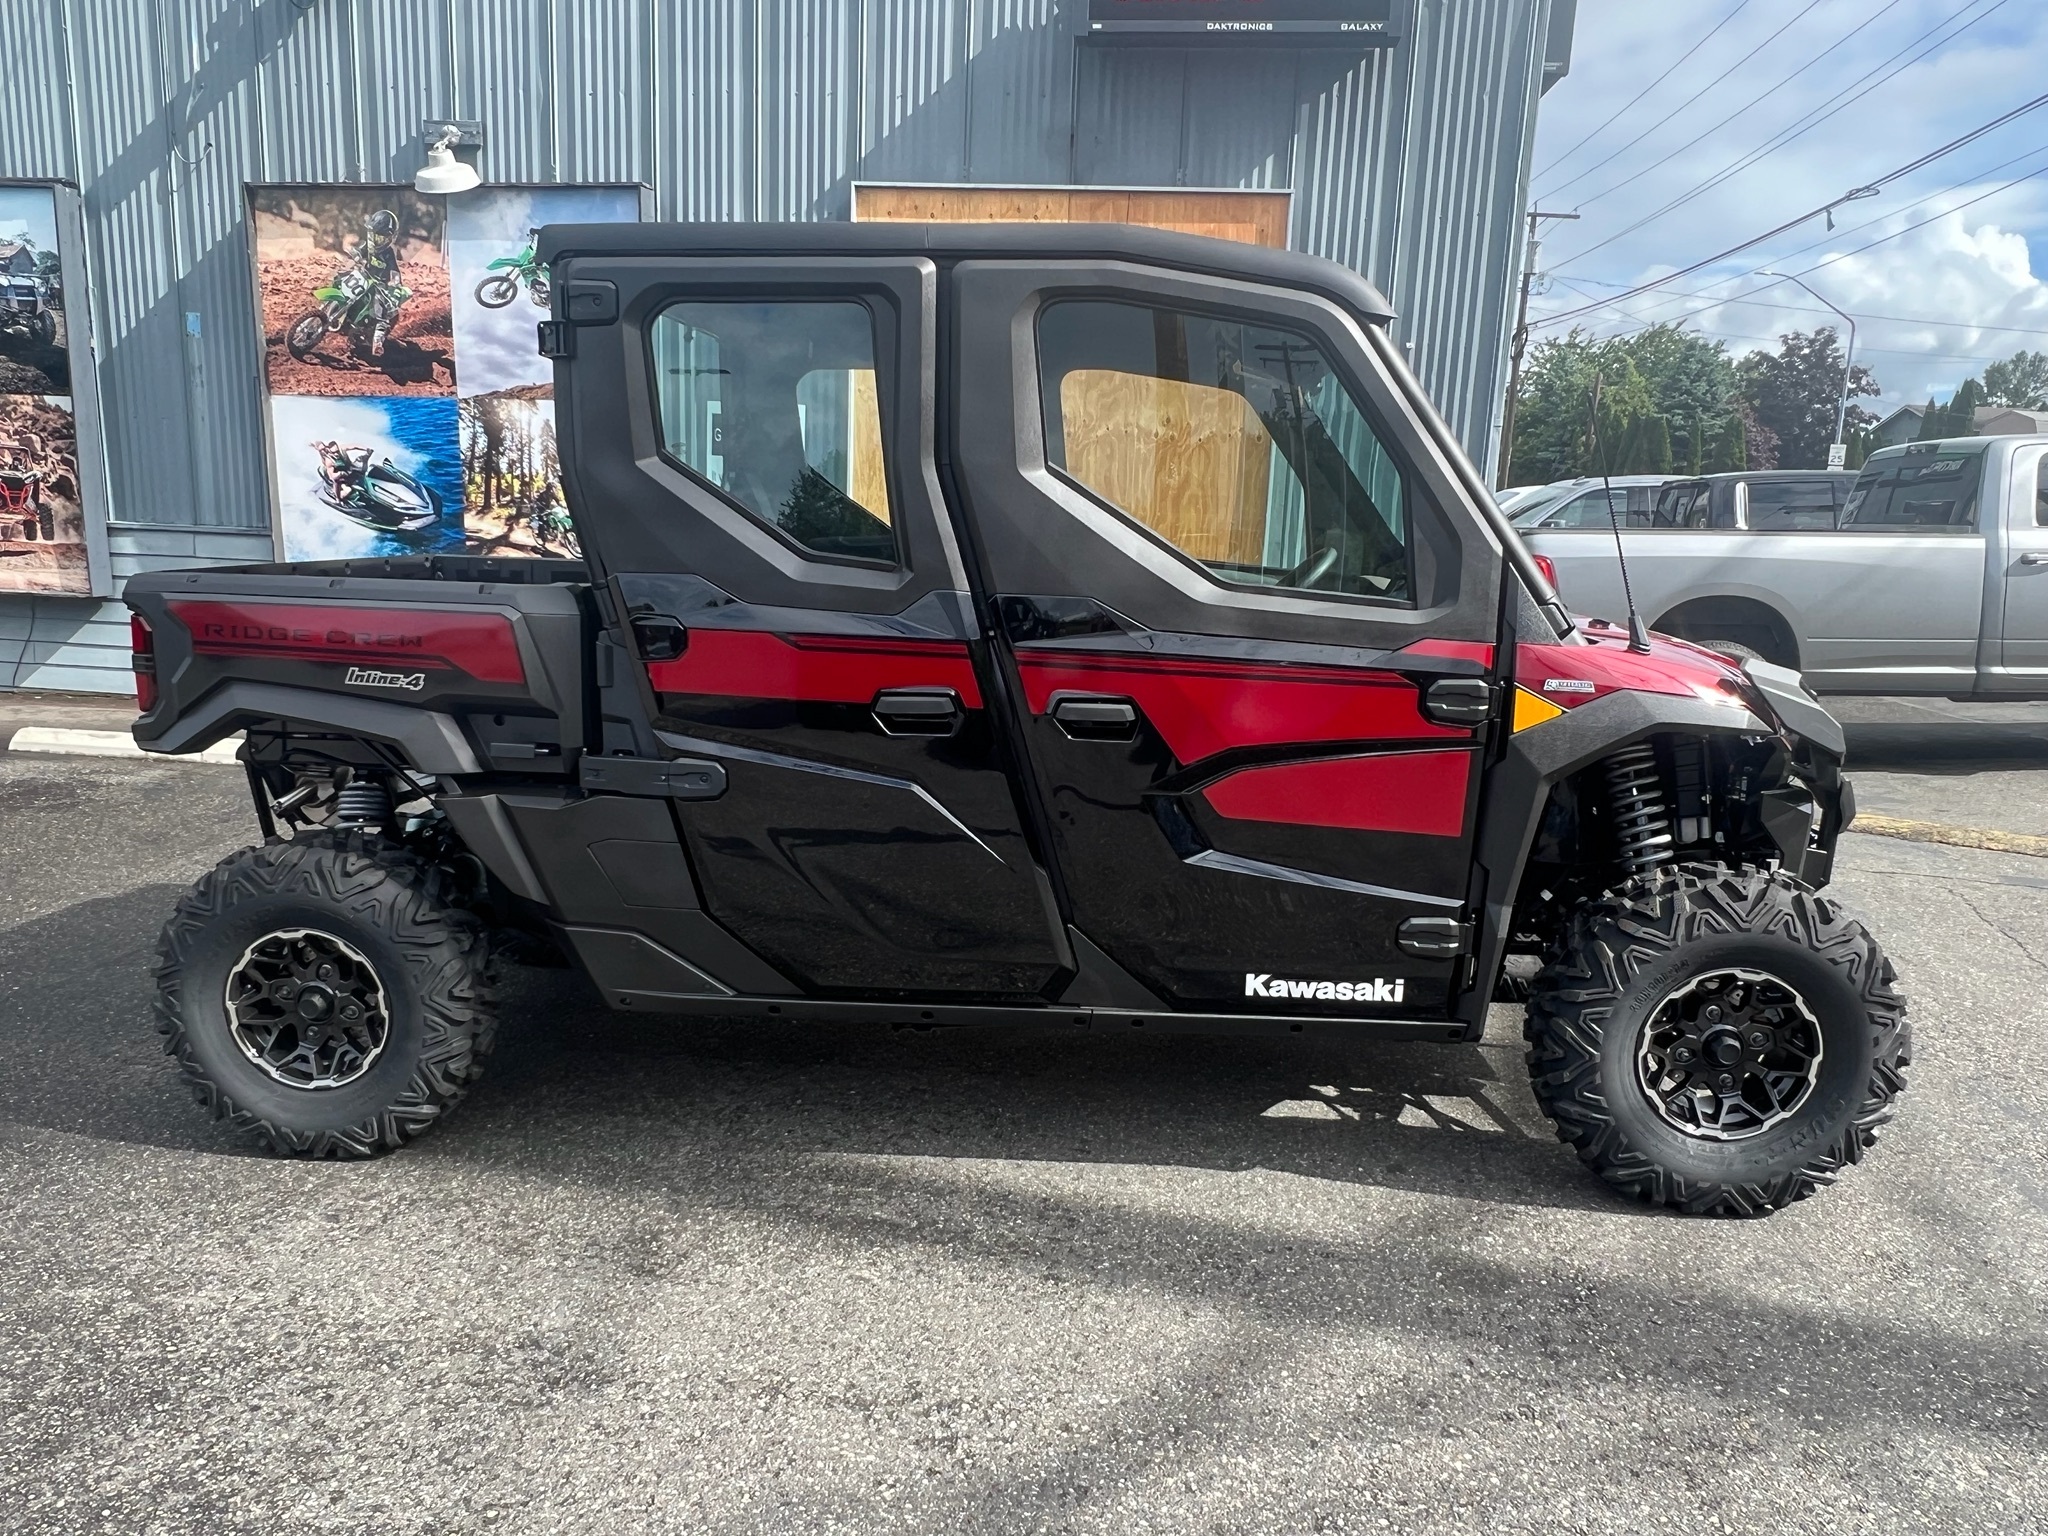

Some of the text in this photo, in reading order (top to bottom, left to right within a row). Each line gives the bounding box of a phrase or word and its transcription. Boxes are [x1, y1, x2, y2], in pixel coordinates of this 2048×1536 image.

[1340, 22, 1384, 31] GALAXY
[1830, 455, 1843, 464] 25
[204, 623, 422, 647] RIDGE CREW
[345, 667, 425, 690] Inline-4
[1245, 973, 1404, 1002] Kawasaki
